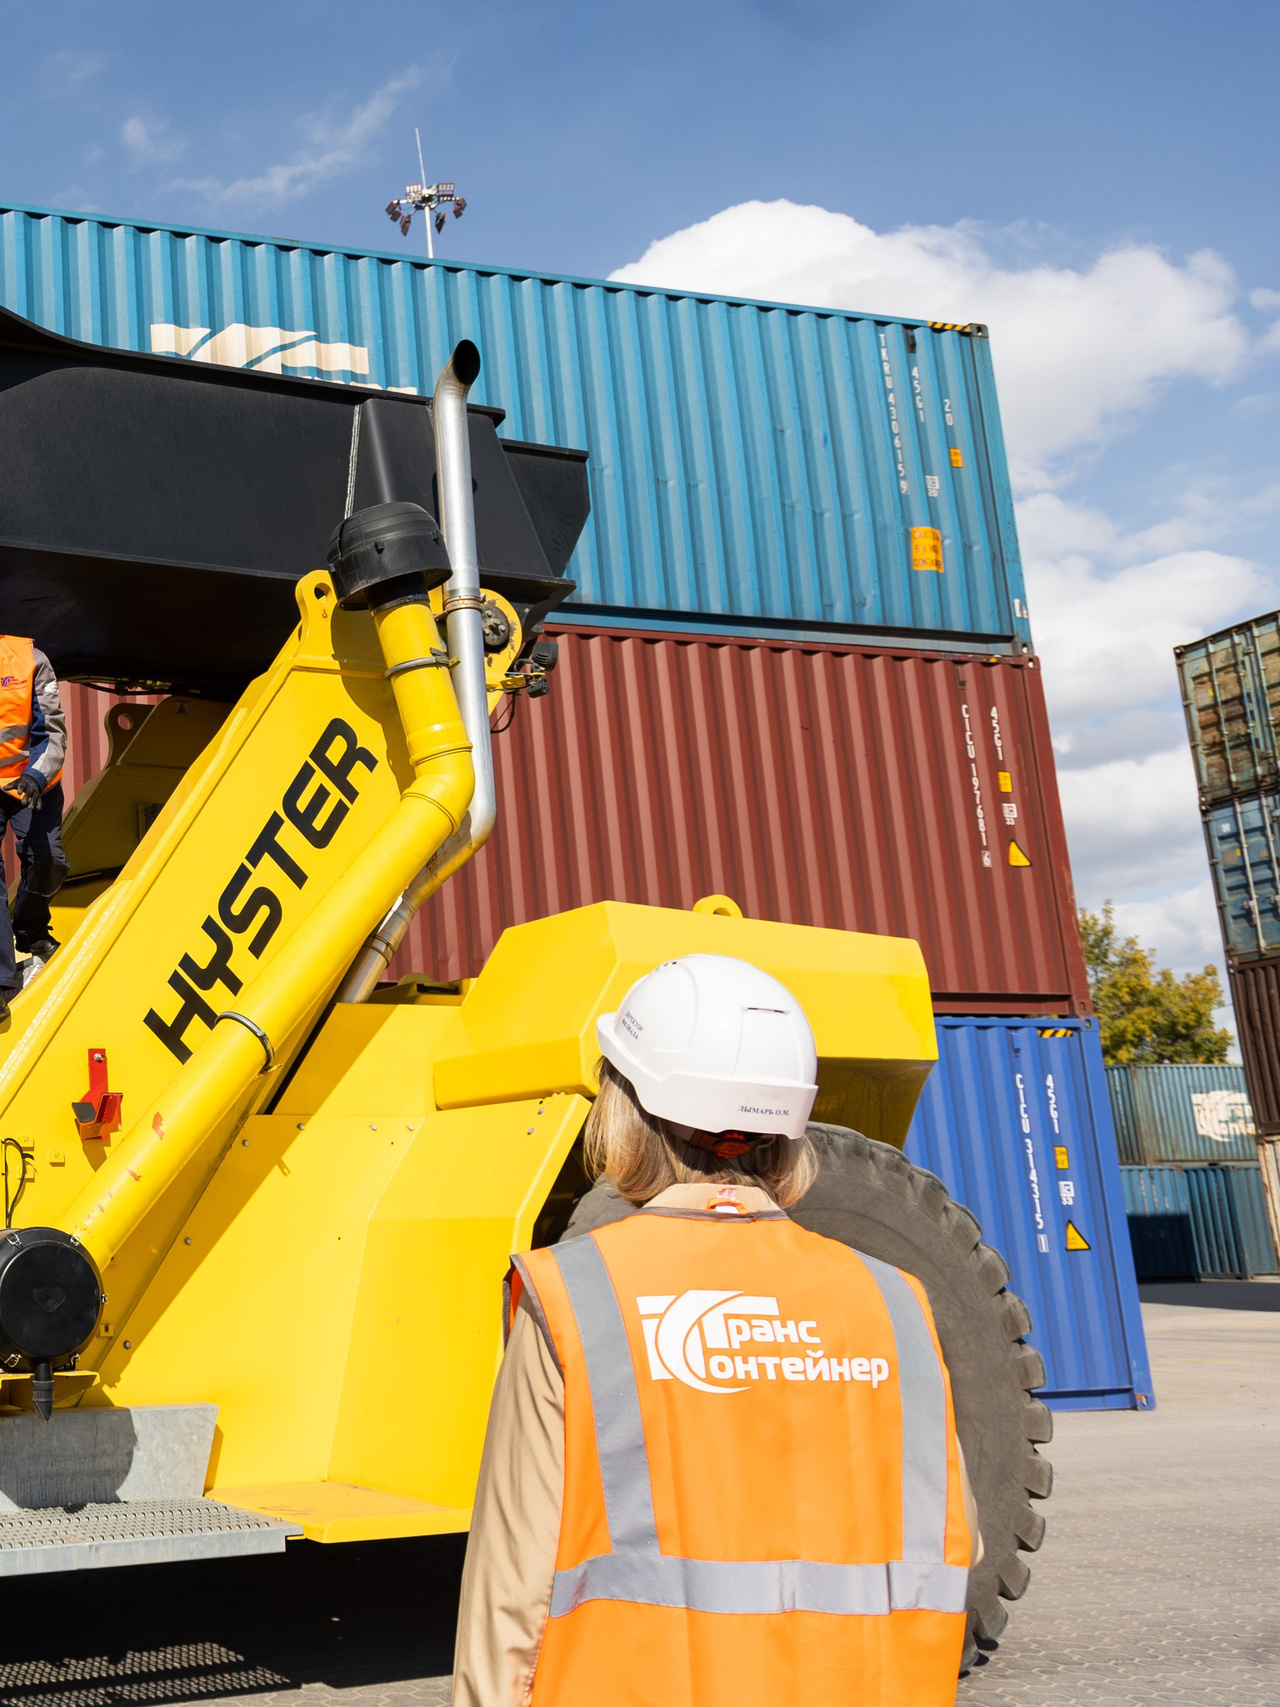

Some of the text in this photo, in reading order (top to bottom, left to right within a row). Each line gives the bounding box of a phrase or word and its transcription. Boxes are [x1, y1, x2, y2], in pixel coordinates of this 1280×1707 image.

[879, 333, 894, 389] TKRU
[887, 392, 906, 477] 430615
[961, 704, 976, 759] CICU
[970, 763, 987, 847] 197681
[990, 706, 1003, 761] 45G1
[143, 717, 379, 1065] HYSTER
[737, 1105, 774, 1116] ЛЫМАРЬ
[1015, 1073, 1030, 1134] CICU
[1024, 1138, 1044, 1230] 314315
[1045, 1073, 1060, 1134] 45G1
